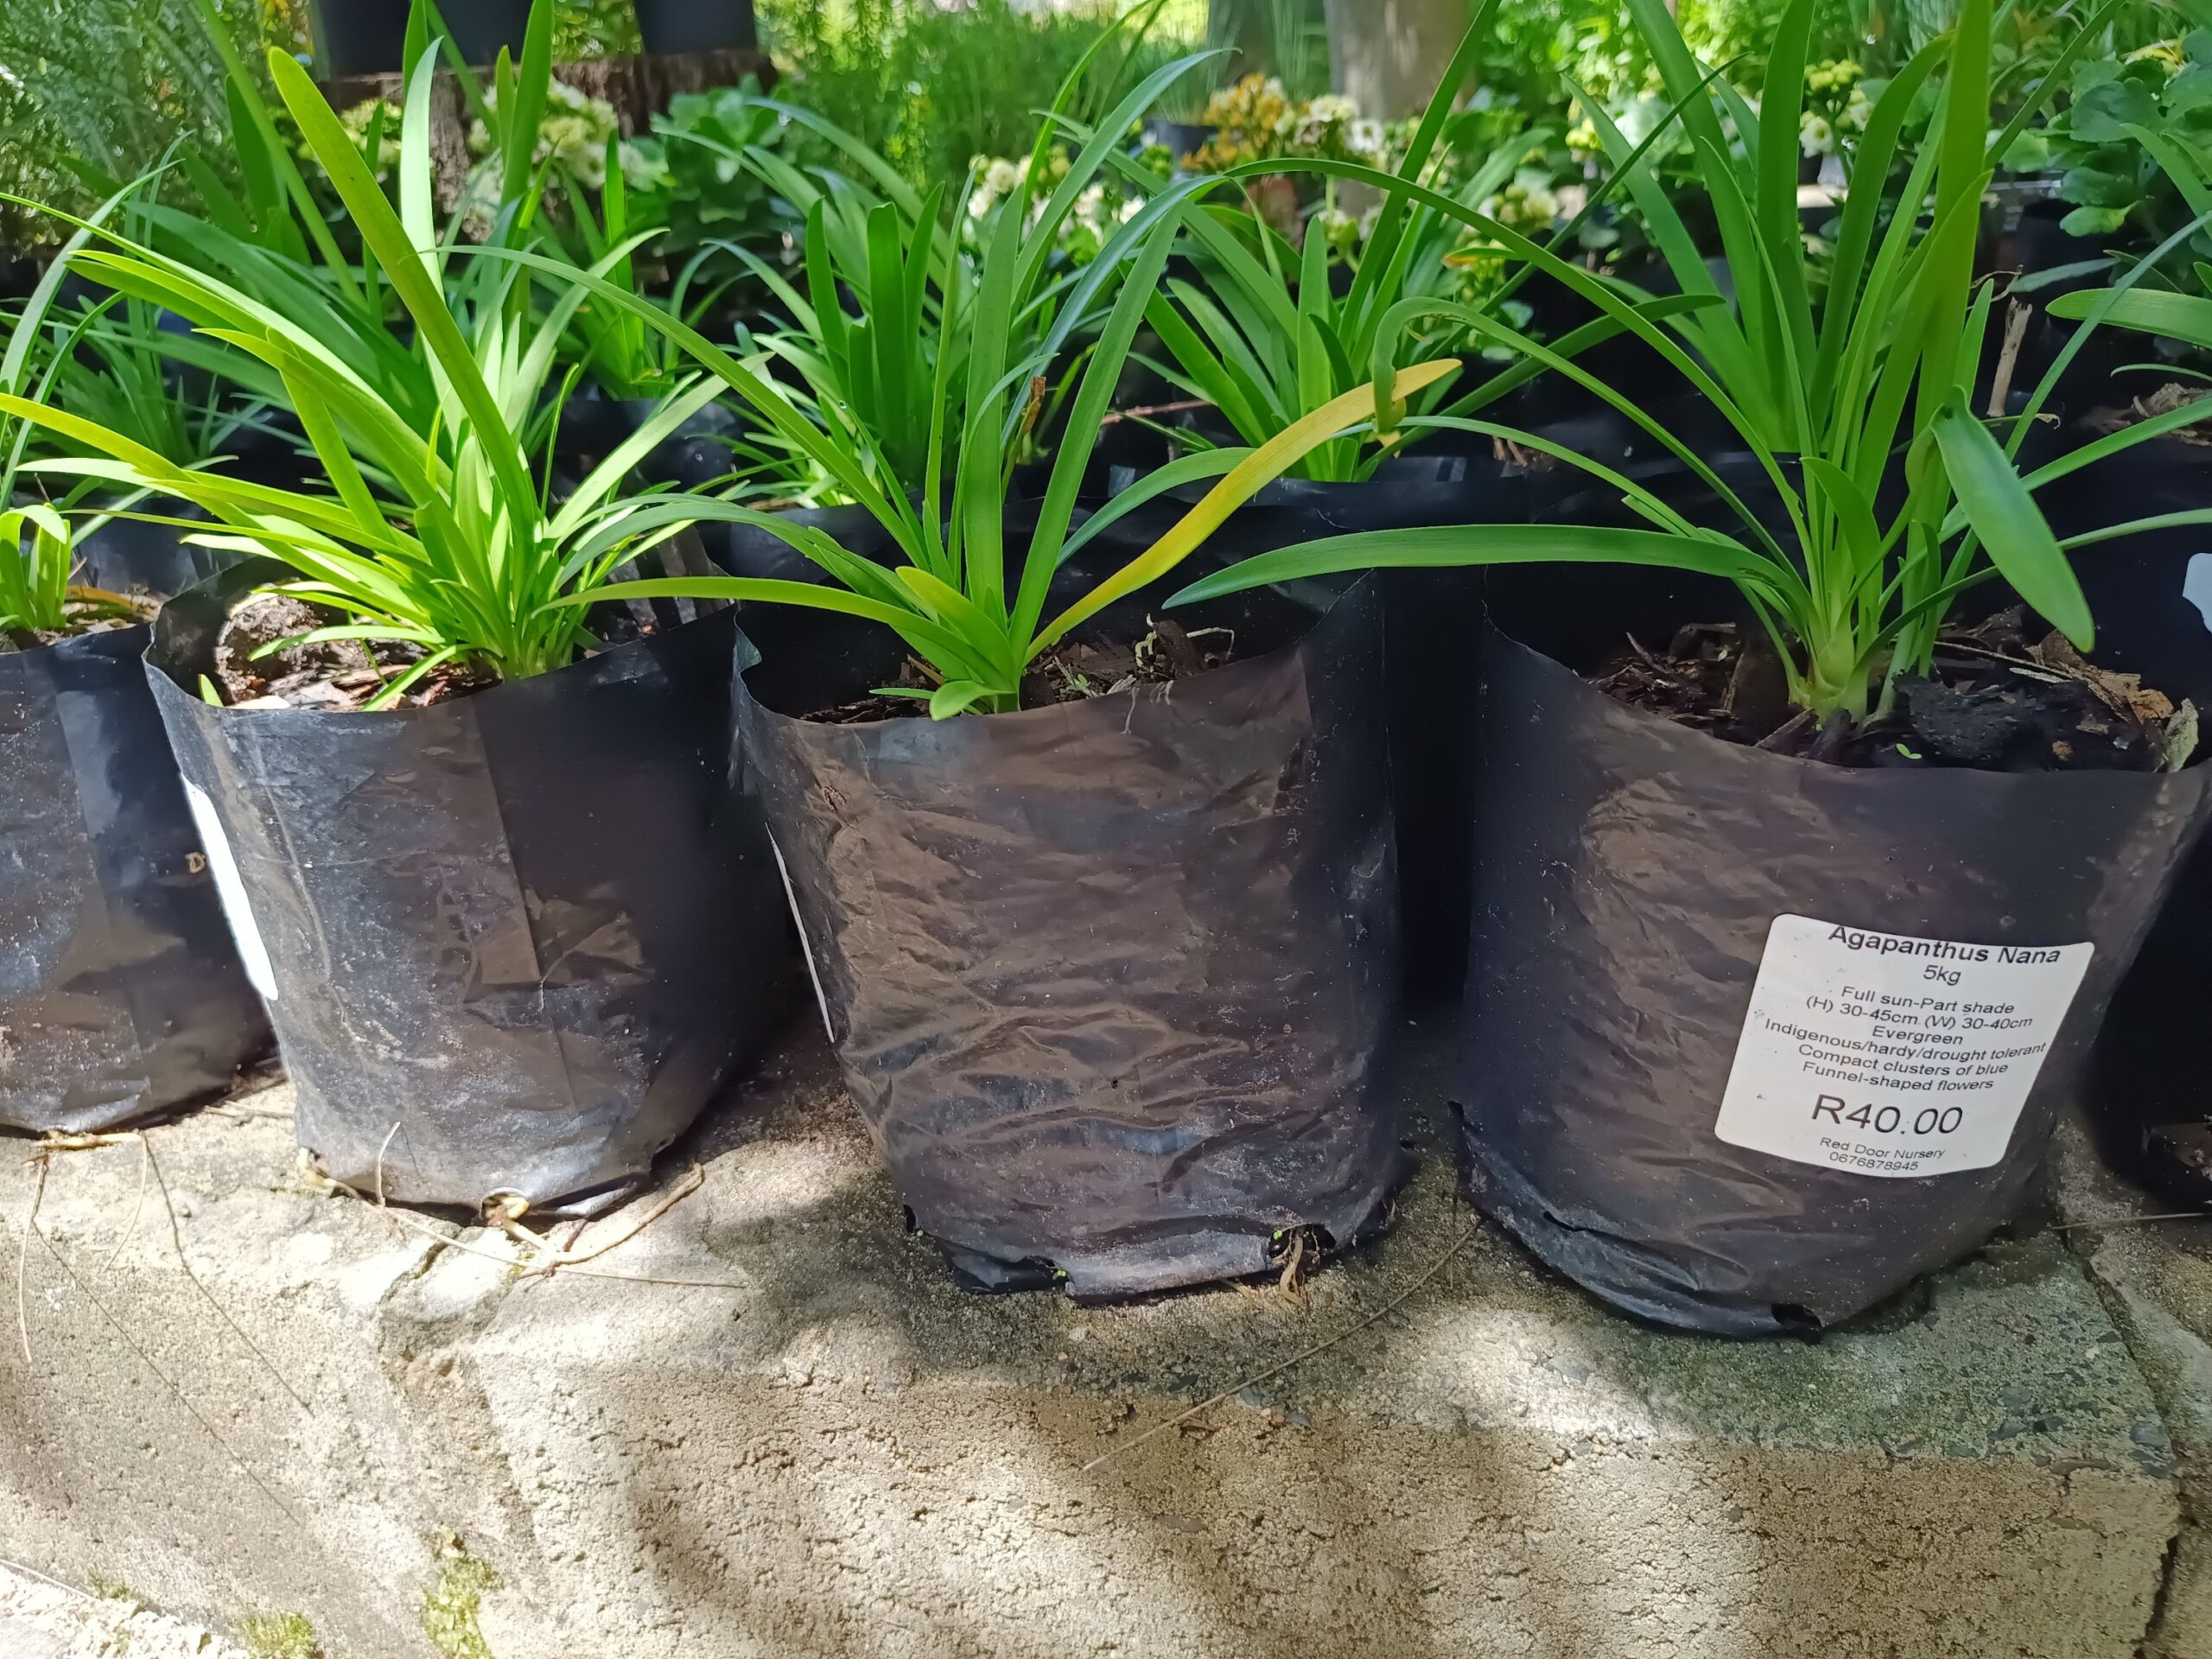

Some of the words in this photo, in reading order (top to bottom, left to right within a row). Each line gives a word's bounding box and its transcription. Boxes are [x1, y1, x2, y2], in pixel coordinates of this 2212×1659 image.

[1828, 925, 1989, 962] Agapanthus
[1997, 947, 2061, 964] Nana
[1923, 964, 1961, 986] 5kg
[1806, 995, 1834, 1014] (H)
[1924, 1014, 1956, 1030] (W)
[1961, 1018, 2033, 1030] 30-40cm
[1841, 986, 1876, 1003] Full
[1880, 995, 1958, 1012] sun-Part
[1962, 1002, 2014, 1014] shade
[1765, 1018, 1986, 1063] Indigenous/hardy/drought
[1990, 1042, 2046, 1059] tolerant
[1872, 1026, 1963, 1045] Evergreen
[1799, 1044, 1878, 1070] Compact
[1884, 1061, 1950, 1076] clusters
[1955, 1065, 1974, 1076] of
[1975, 1064, 2008, 1075] blue
[1802, 1061, 1933, 1091] Funnel-shaped
[1936, 1080, 1993, 1091] flowers
[1811, 1094, 1963, 1135] R40.00
[1820, 1137, 1850, 1151] Red
[1854, 1144, 1891, 1158] Door
[1894, 1148, 1946, 1160] Nursery
[1829, 1151, 1919, 1171] 0676878945
